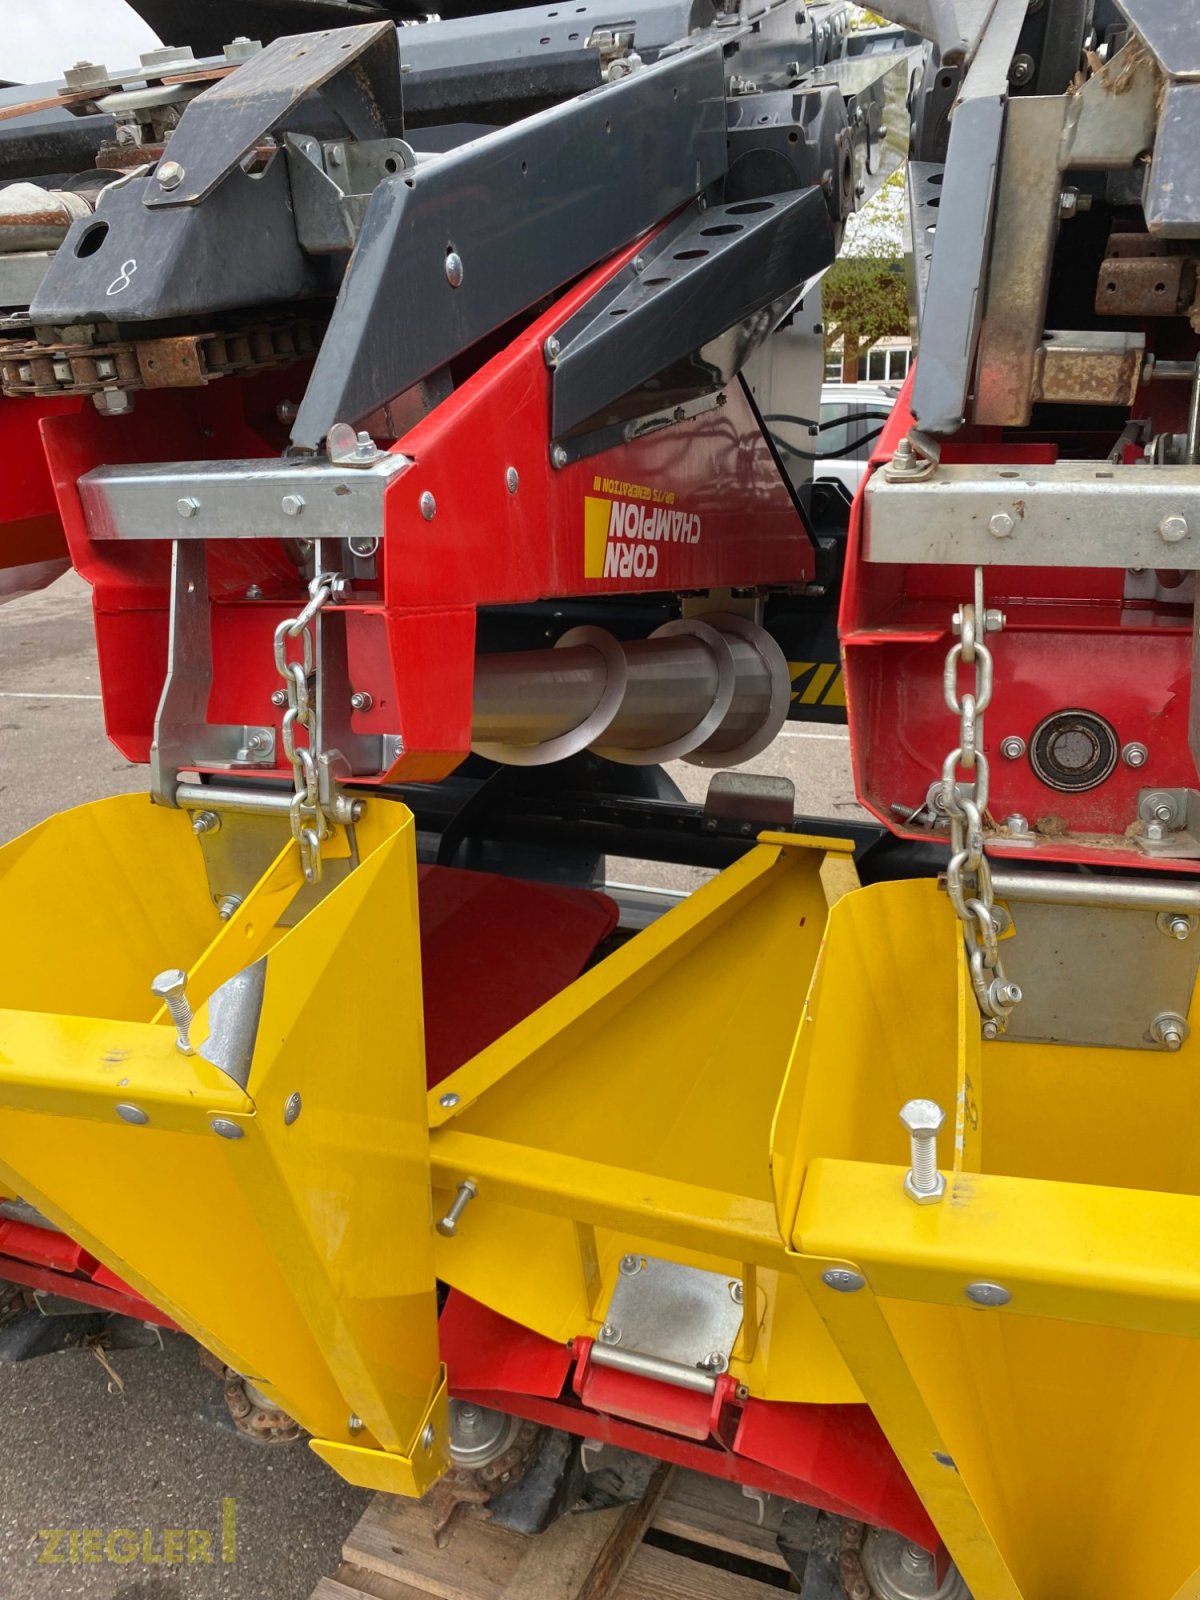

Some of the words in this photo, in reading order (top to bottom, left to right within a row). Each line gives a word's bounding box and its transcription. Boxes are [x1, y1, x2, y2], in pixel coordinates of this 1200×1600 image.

[106, 259, 138, 296] 8
[602, 477, 651, 501] GENERATION
[609, 501, 701, 544] CHAMPION
[603, 542, 658, 578] CORN
